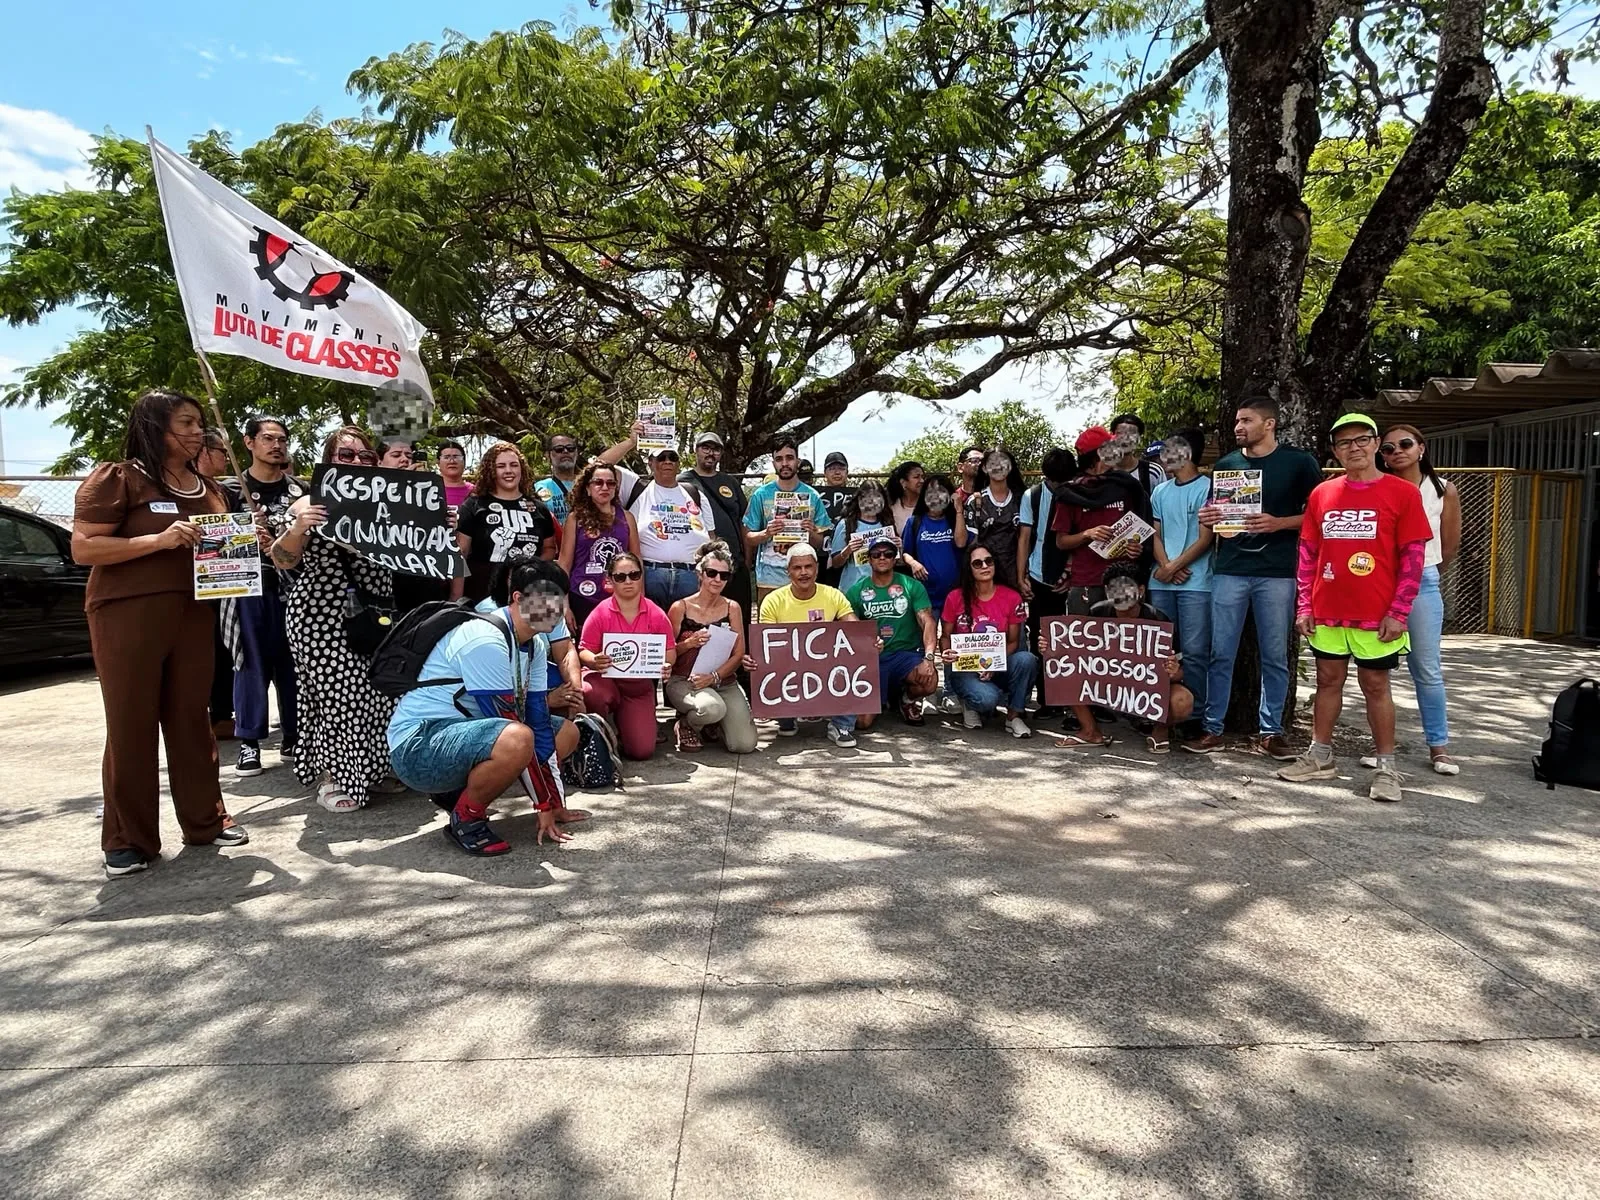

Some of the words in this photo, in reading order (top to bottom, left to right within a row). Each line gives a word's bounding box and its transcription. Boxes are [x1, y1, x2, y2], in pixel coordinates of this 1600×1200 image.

[216, 292, 399, 352] MOVIMENTO
[213, 306, 257, 341] LUTA
[260, 324, 284, 349] DE
[285, 330, 401, 379] CLASSES
[321, 467, 440, 511] RESPEITE
[376, 501, 390, 523] A
[501, 509, 534, 533] UP
[1323, 510, 1377, 522] CSP
[208, 526, 236, 537] UGUEL?
[1324, 521, 1374, 534] Conlutas
[863, 601, 894, 618] Veras
[762, 627, 855, 664] FICA
[964, 633, 990, 643] DIÁLOGO
[1049, 620, 1172, 659] RESPEITE
[1045, 655, 1075, 679] OS
[1078, 656, 1159, 685] NOSSOS
[759, 671, 823, 706] CED
[1079, 679, 1164, 721] ALUNOS
